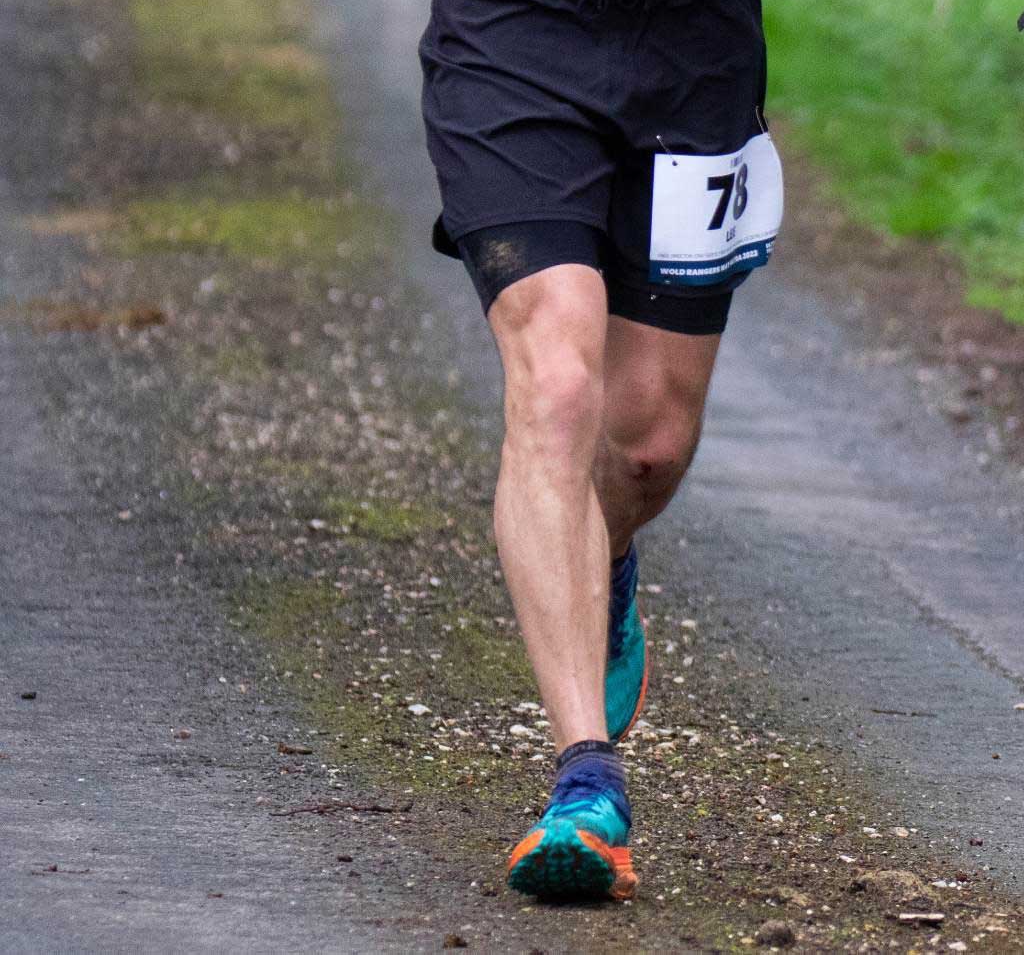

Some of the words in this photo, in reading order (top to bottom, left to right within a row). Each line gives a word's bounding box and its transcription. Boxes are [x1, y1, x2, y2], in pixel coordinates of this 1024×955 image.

[707, 162, 748, 231] 78
[660, 268, 685, 276] WOLD
[686, 265, 721, 276] RANGERS
